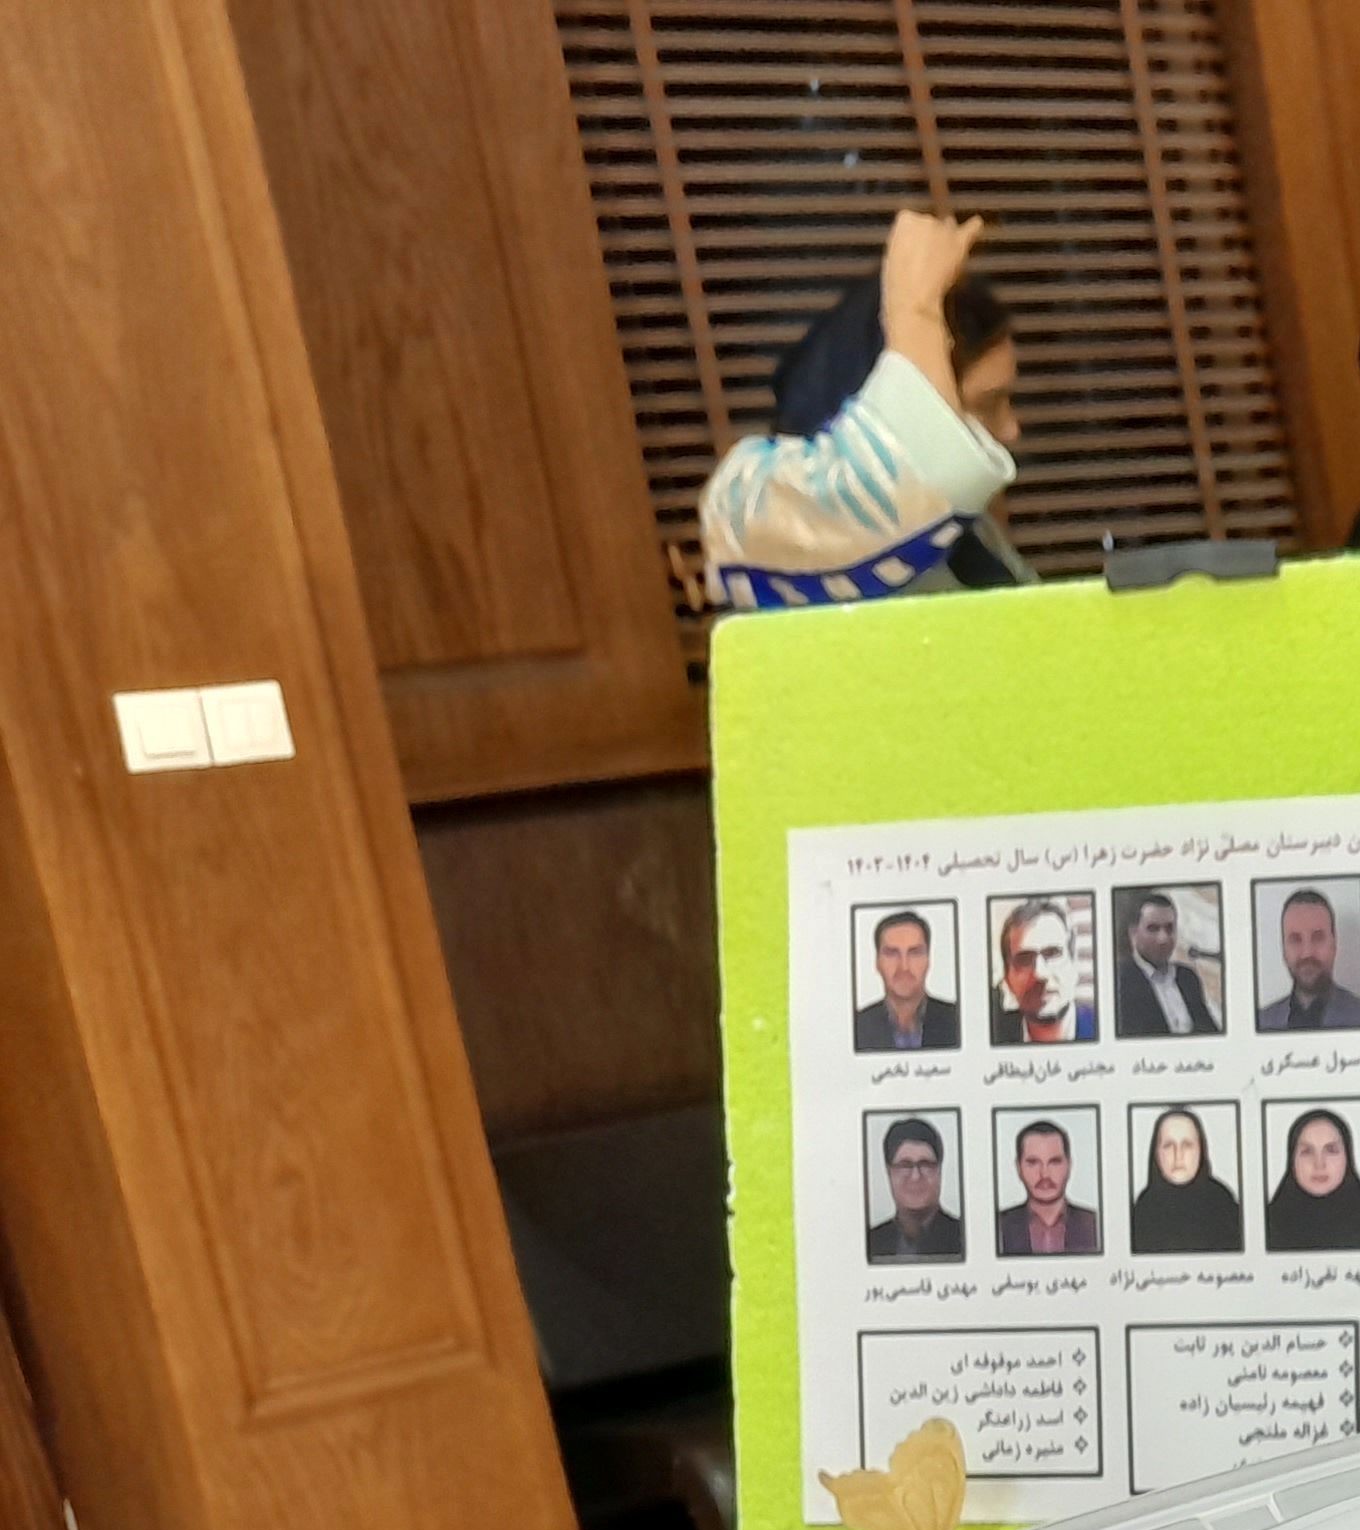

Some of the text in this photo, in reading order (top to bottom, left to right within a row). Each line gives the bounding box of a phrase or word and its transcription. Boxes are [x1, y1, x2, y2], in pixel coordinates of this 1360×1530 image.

[1084, 842, 1116, 867] زهرا
[1121, 843, 1173, 865] حضرت
[1267, 832, 1341, 857] دبیرستان
[937, 850, 999, 877] تحصیلی
[1006, 847, 1038, 872] سال
[1175, 1058, 1214, 1073] محمد
[1261, 1054, 1320, 1076] عسکری
[992, 1277, 1087, 1297] مهدی یوسفی
[1197, 1269, 1254, 1285] معصومه
[938, 1281, 978, 1301] مهدی
[1213, 1340, 1234, 1358] پور
[1241, 1334, 1281, 1358] الدین
[1287, 1334, 1327, 1354] حسام
[951, 1353, 968, 1375] ای
[1026, 1351, 1061, 1368] احمد
[1272, 1369, 1328, 1386] معصومه
[890, 1382, 927, 1405] الدین
[932, 1384, 958, 1405] زین
[1022, 1380, 1063, 1398] فاطمه
[1179, 1394, 1210, 1417] زاده
[1282, 1391, 1325, 1413] فهیمه
[1037, 1409, 1064, 1424] اسد
[1293, 1421, 1328, 1445] غزاله
[982, 1439, 1064, 1461] منیره زمانی
